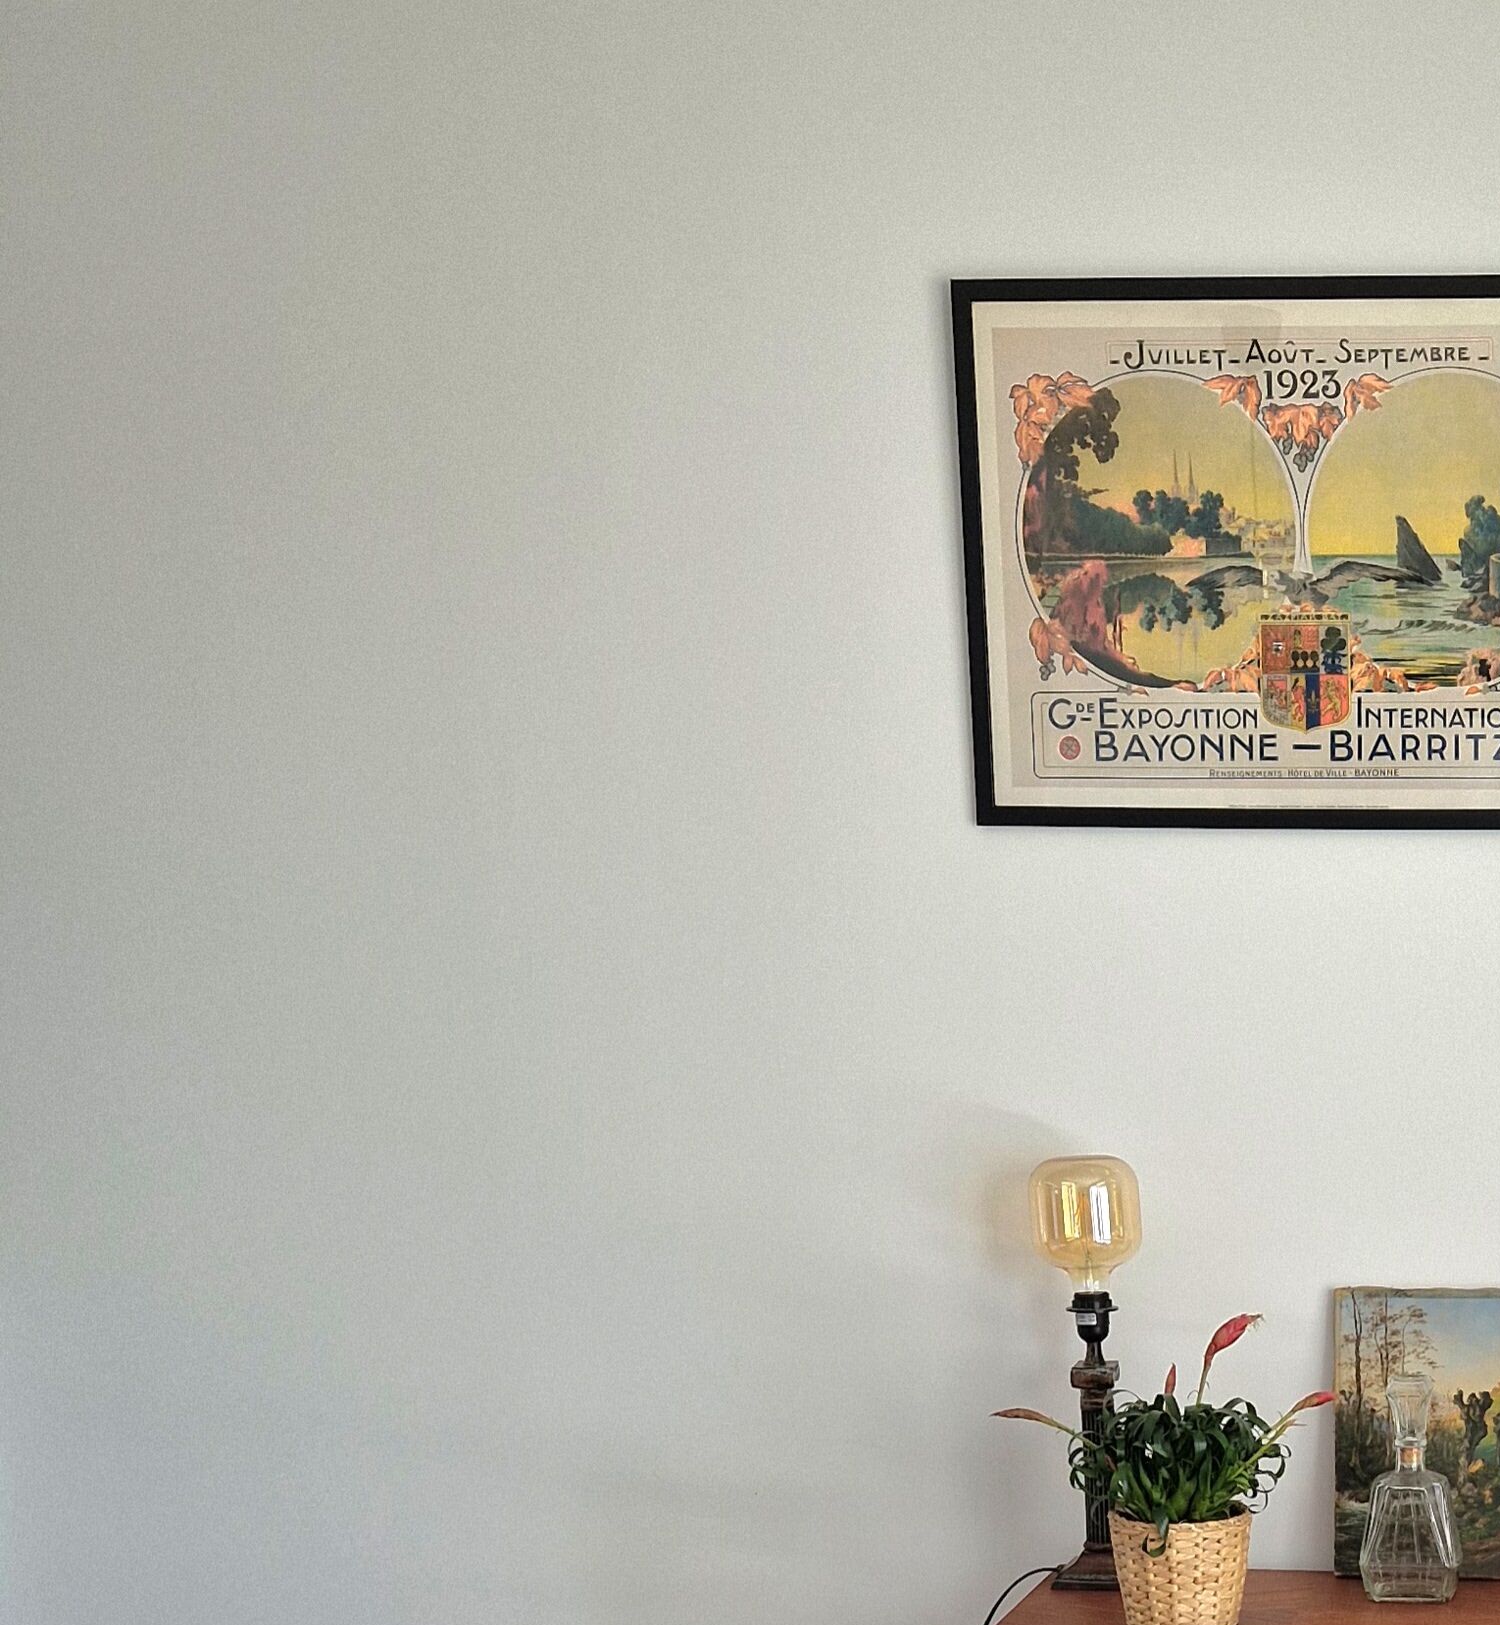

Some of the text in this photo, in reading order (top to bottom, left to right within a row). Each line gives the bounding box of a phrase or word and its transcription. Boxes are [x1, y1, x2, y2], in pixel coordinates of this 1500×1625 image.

[1334, 338, 1470, 370] SEPTEMBRE
[1263, 369, 1341, 399] 1923
[1099, 697, 1258, 729] EXPOSITION
[1094, 730, 1279, 762] BAYONNE
[1354, 768, 1399, 777] BAYONNE
